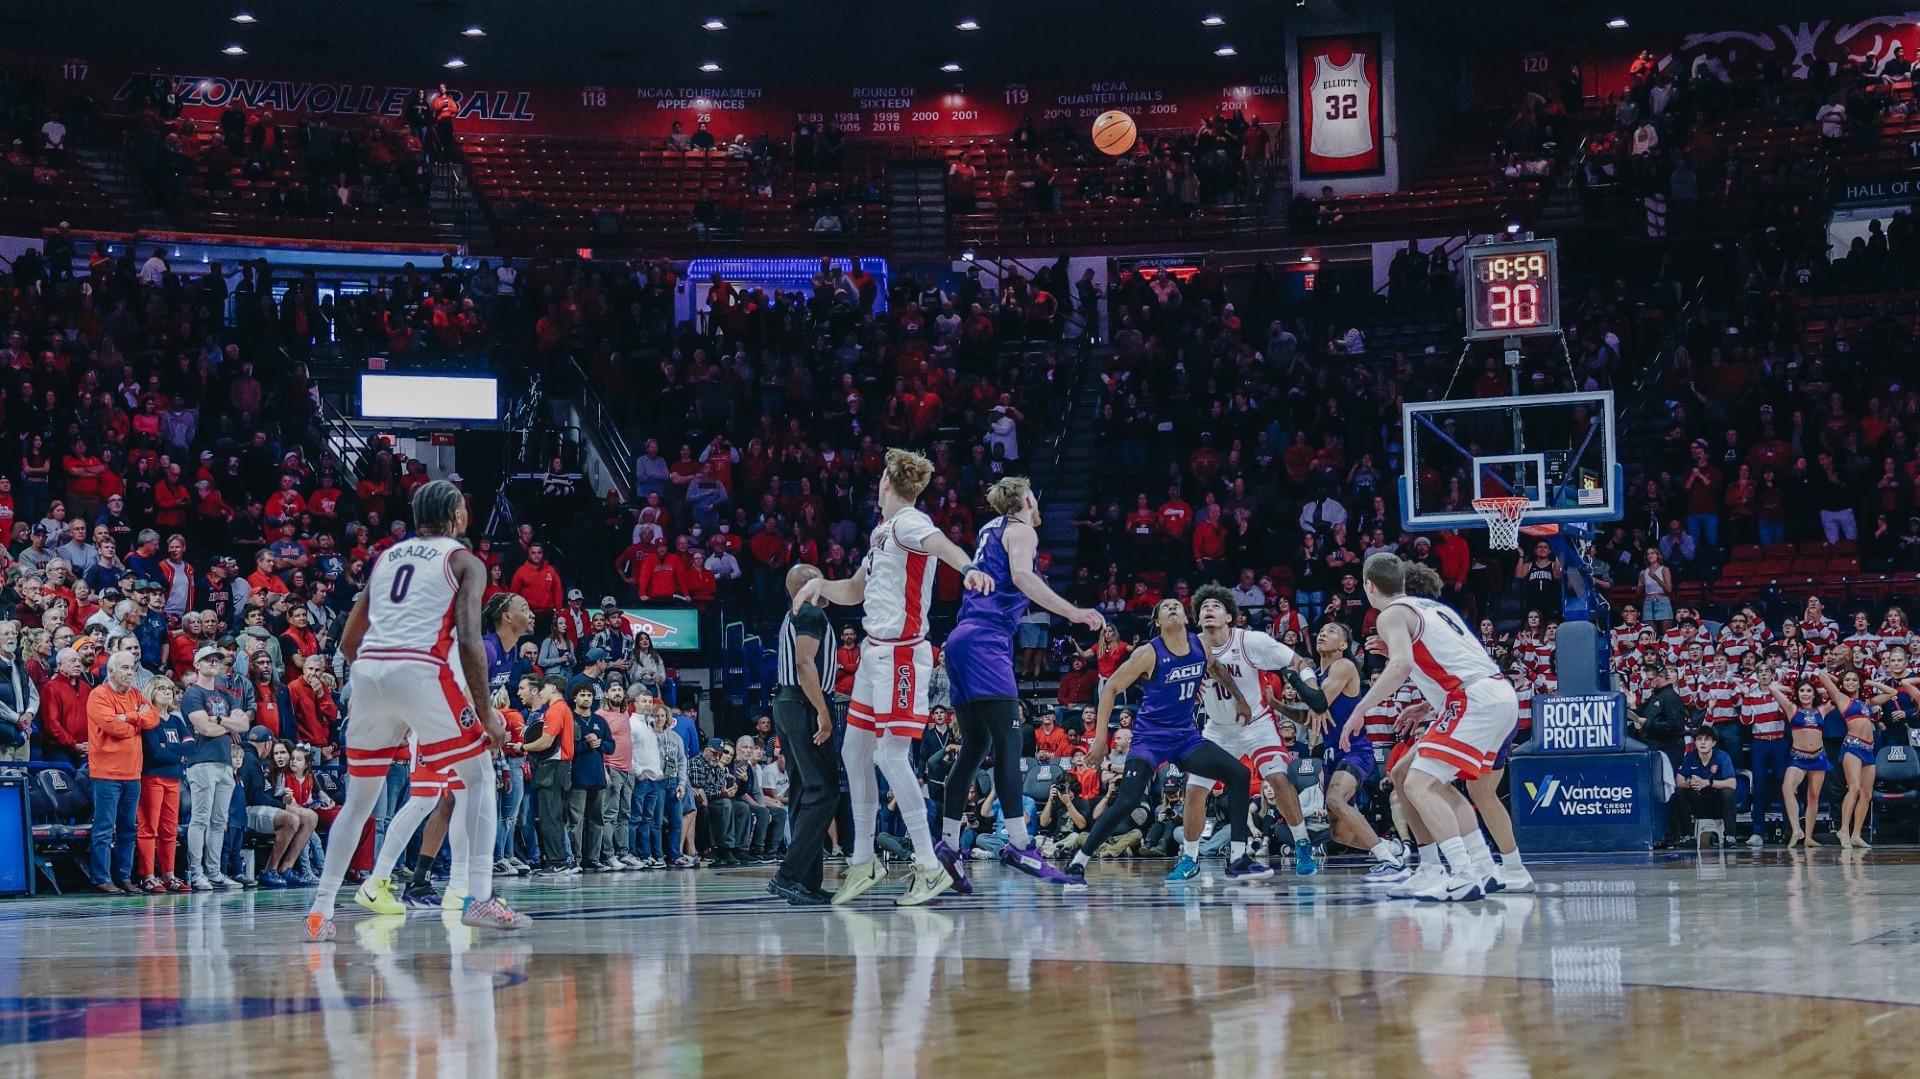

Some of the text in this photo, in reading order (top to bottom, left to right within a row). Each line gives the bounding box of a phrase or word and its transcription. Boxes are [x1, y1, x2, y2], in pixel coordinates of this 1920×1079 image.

[62, 64, 88, 80] 117
[1523, 57, 1548, 73] 120
[1092, 82, 1128, 92] NCAA
[1323, 79, 1358, 89] ELLIOTT
[580, 92, 606, 107] 118
[638, 88, 763, 98] NCAA TOURNAMENT
[853, 87, 917, 98] ROUND OF
[1004, 90, 1029, 105] 119
[1058, 91, 1163, 105] QUARTER FINALS
[657, 99, 746, 110] APPEARANCES
[860, 99, 911, 109] SIXTEEN
[1150, 104, 1178, 114] 2005
[1221, 101, 1248, 111] 2001
[1325, 94, 1357, 120] 32
[697, 114, 711, 123] 26
[797, 113, 824, 123] 193
[873, 112, 900, 123] 1999
[912, 112, 939, 121] 2000
[952, 111, 979, 120] 2001
[837, 123, 900, 132] 005 2016
[1847, 184, 1884, 198] HALL
[1891, 181, 1910, 194] OF
[1488, 255, 1543, 281] 19:59
[1488, 284, 1537, 327] 30
[388, 545, 443, 562] BRADLEY
[390, 563, 416, 604] 0
[1436, 611, 1465, 636] 8
[1169, 664, 1203, 681] ACU
[897, 666, 912, 709] CATS
[1179, 682, 1196, 701] 10
[1546, 696, 1584, 704] SHAMROCK
[1543, 701, 1616, 728] ROCKIN'
[1543, 725, 1613, 750] PROTEIN
[1560, 785, 1633, 801] Vantage
[1558, 801, 1603, 816] West
